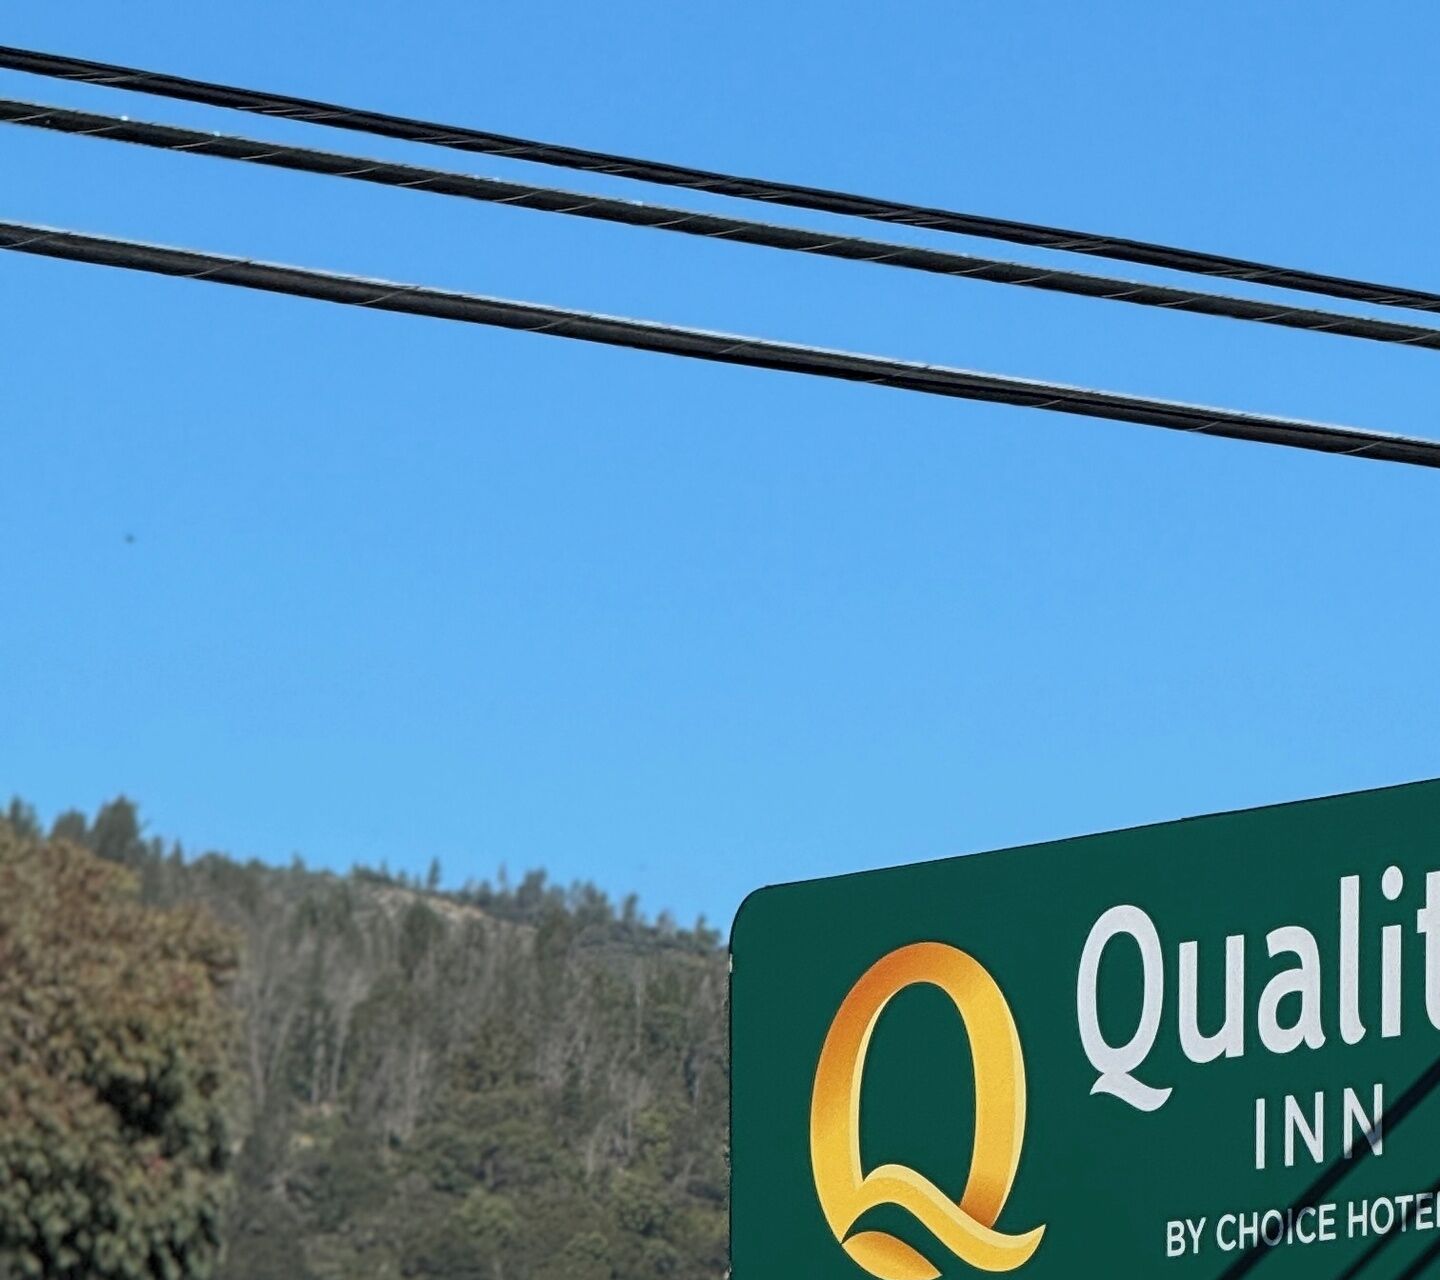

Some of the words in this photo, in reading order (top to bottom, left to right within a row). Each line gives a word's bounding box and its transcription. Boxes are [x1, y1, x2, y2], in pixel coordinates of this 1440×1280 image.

[1255, 1083, 1383, 1169] INN
[1166, 1216, 1207, 1257] BY
[1216, 1203, 1337, 1251] CHOICE
